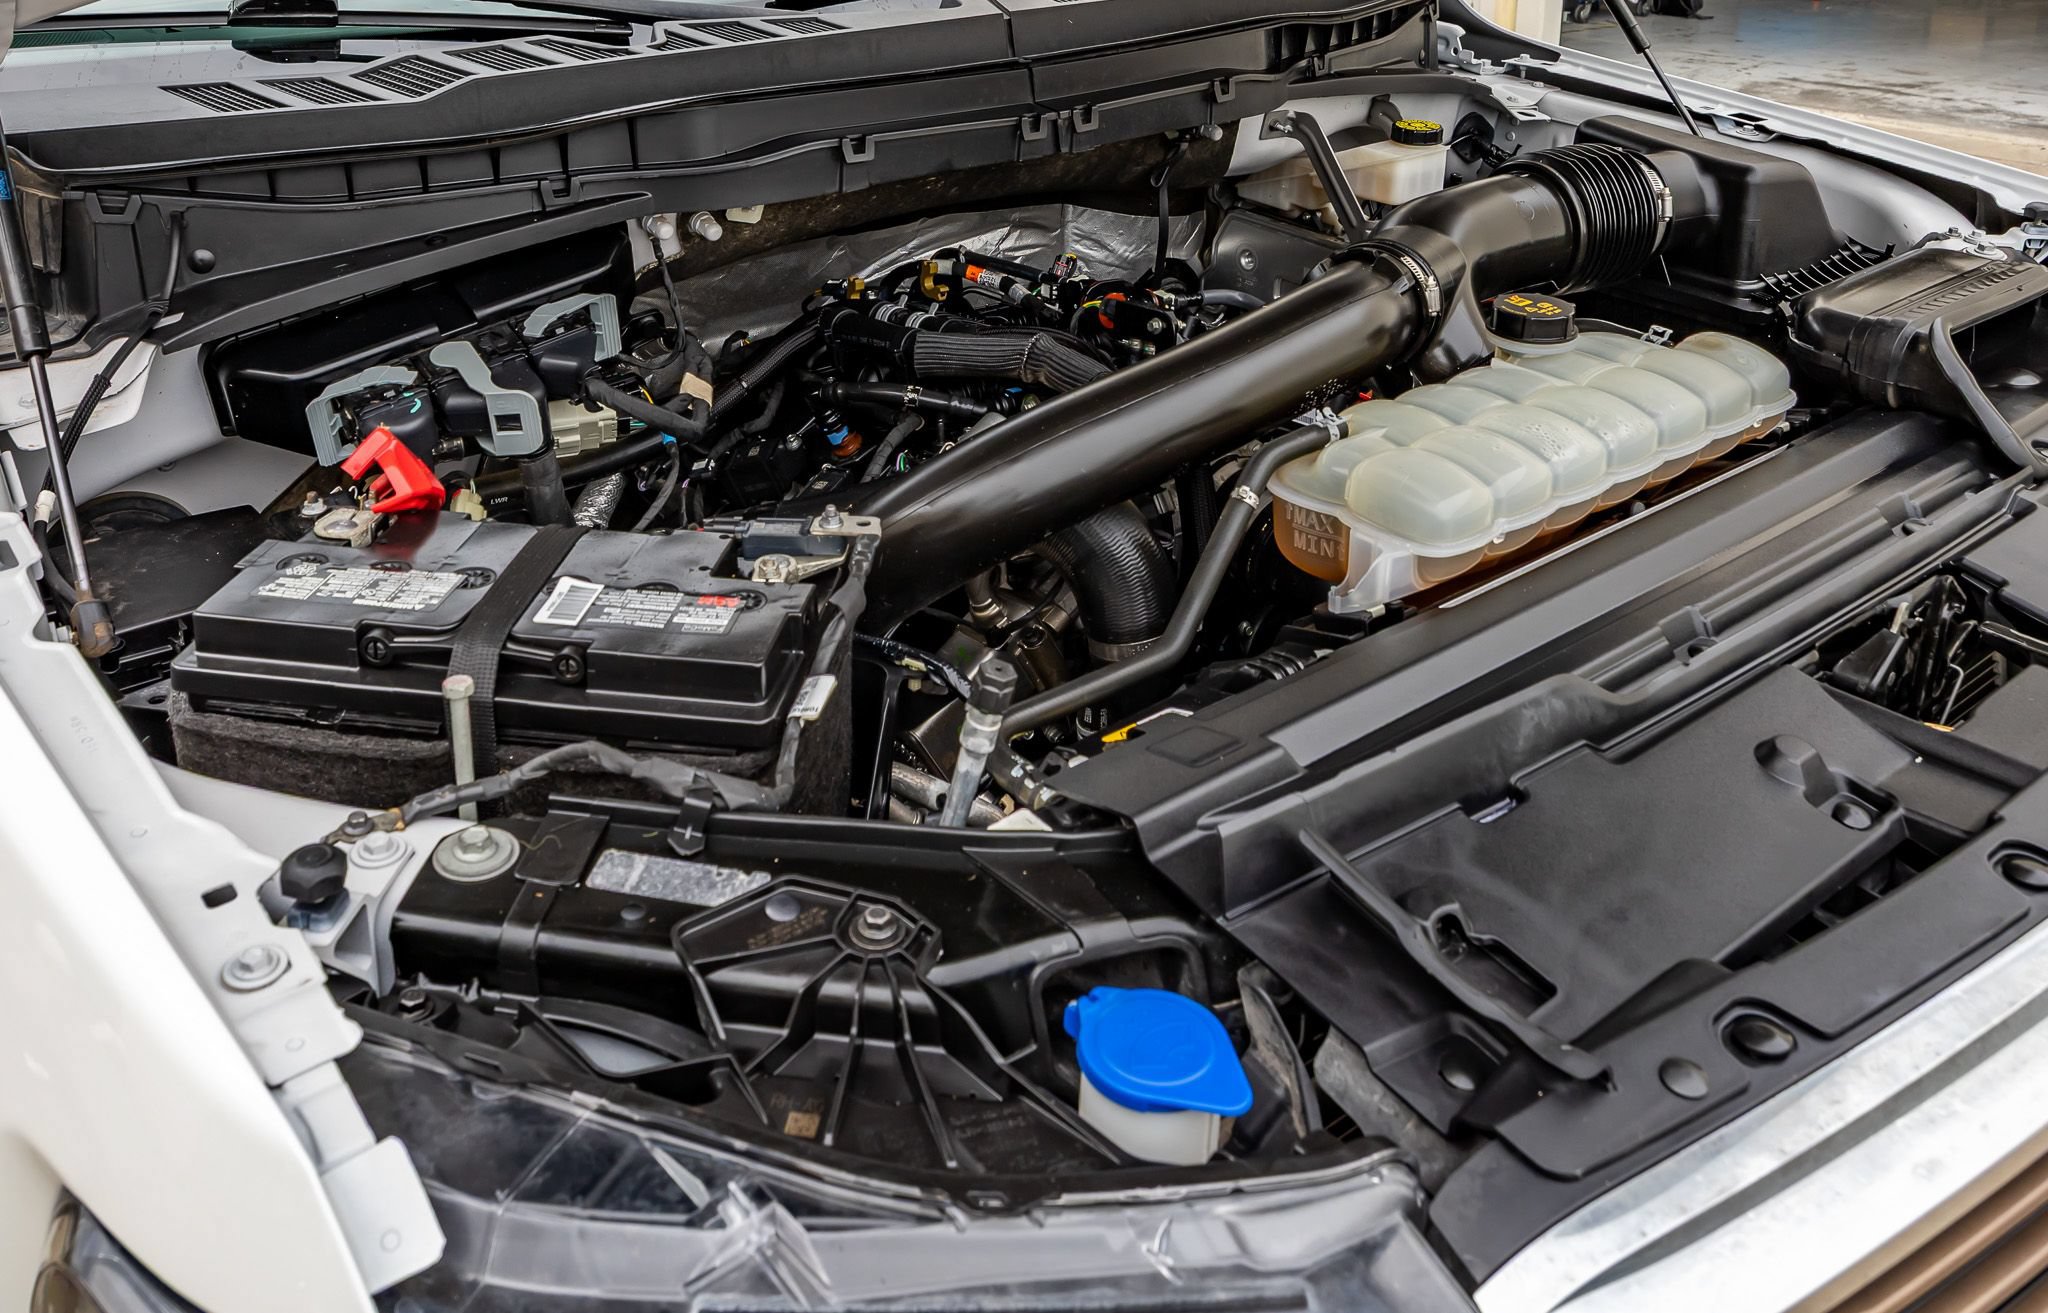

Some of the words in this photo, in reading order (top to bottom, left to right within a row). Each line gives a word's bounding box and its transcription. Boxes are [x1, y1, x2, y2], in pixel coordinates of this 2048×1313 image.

[490, 496, 508, 505] LWR
[1293, 507, 1334, 534] MAX
[1294, 529, 1334, 558] MIN
